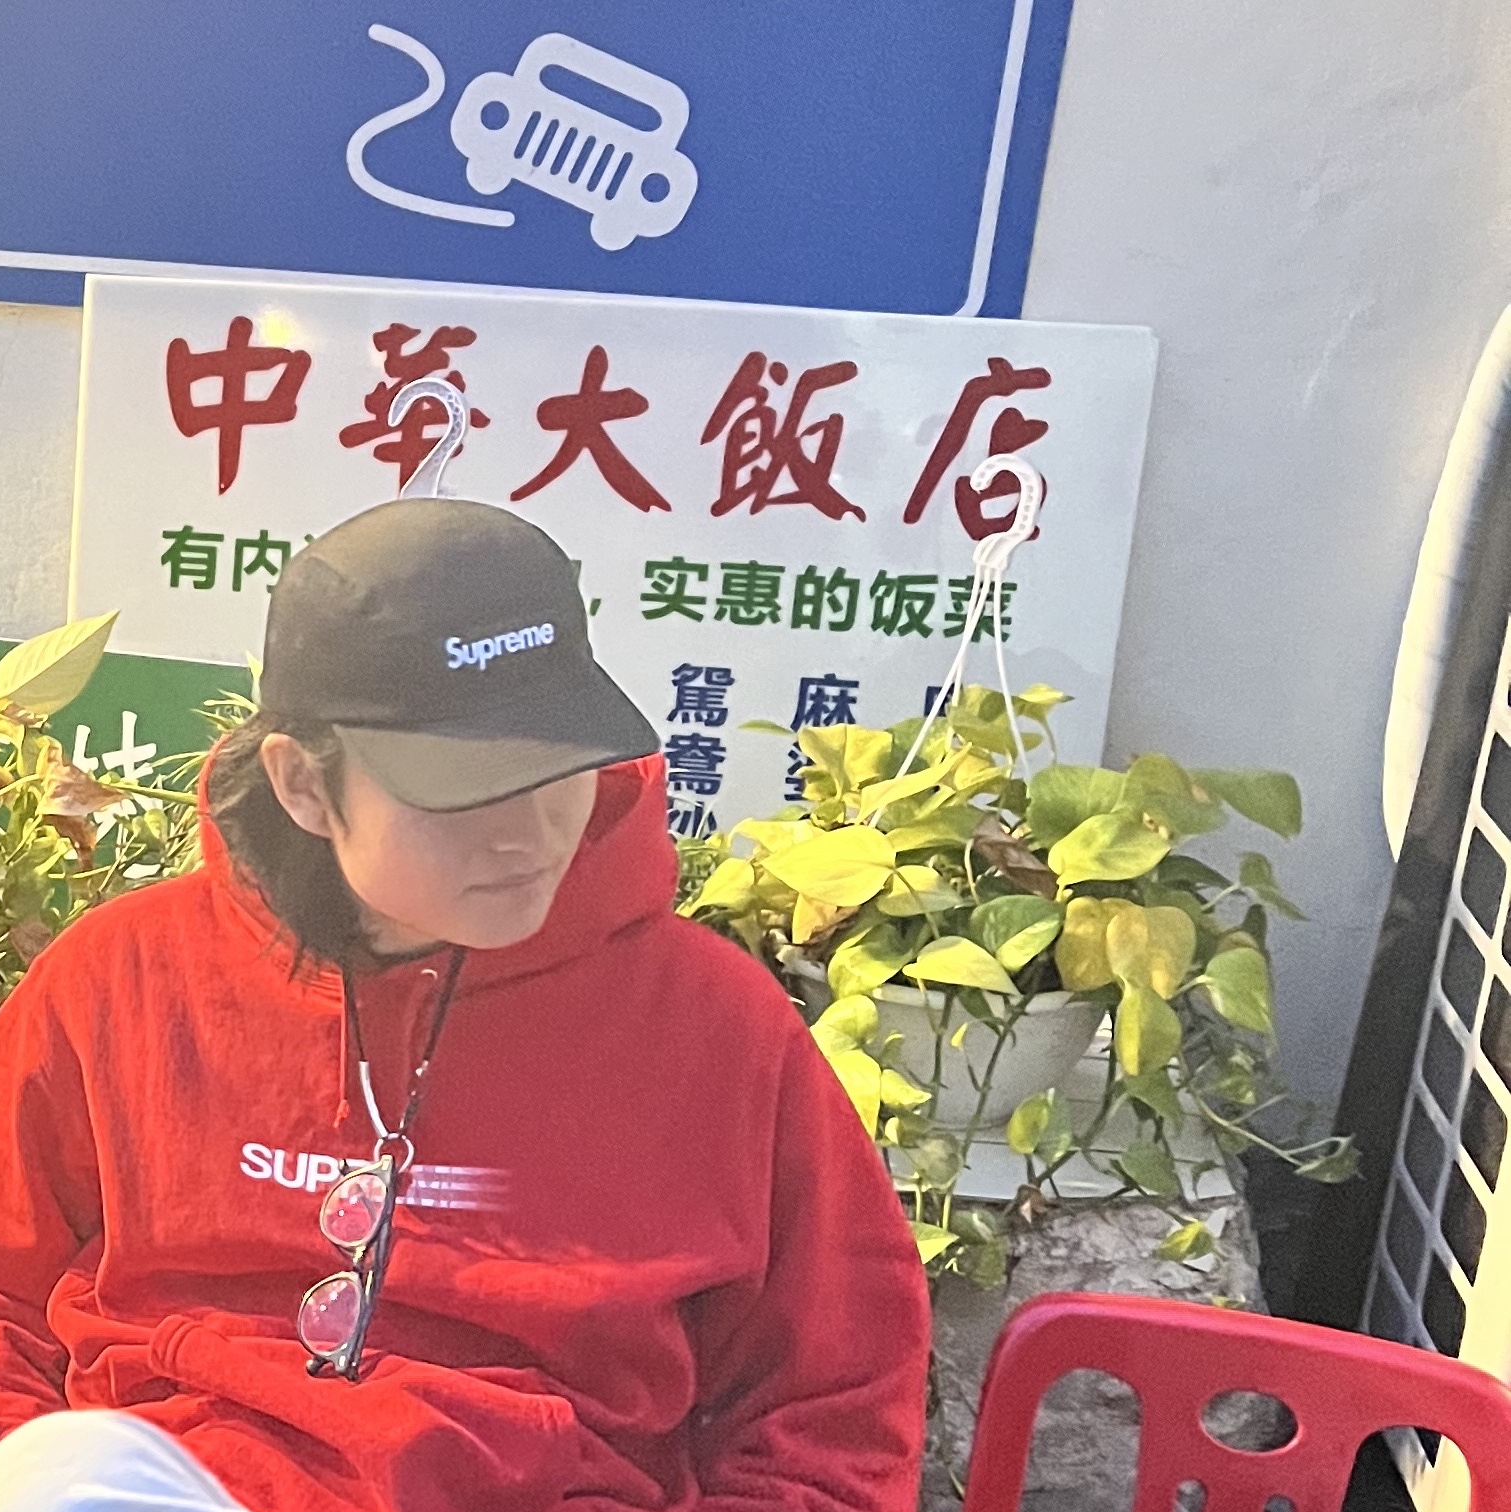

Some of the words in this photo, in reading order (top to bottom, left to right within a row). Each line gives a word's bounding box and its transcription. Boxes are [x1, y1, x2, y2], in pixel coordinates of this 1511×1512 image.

[165, 315, 1052, 542] 中華大飯店
[160, 525, 314, 592] 有内
[445, 622, 555, 671] Supreme
